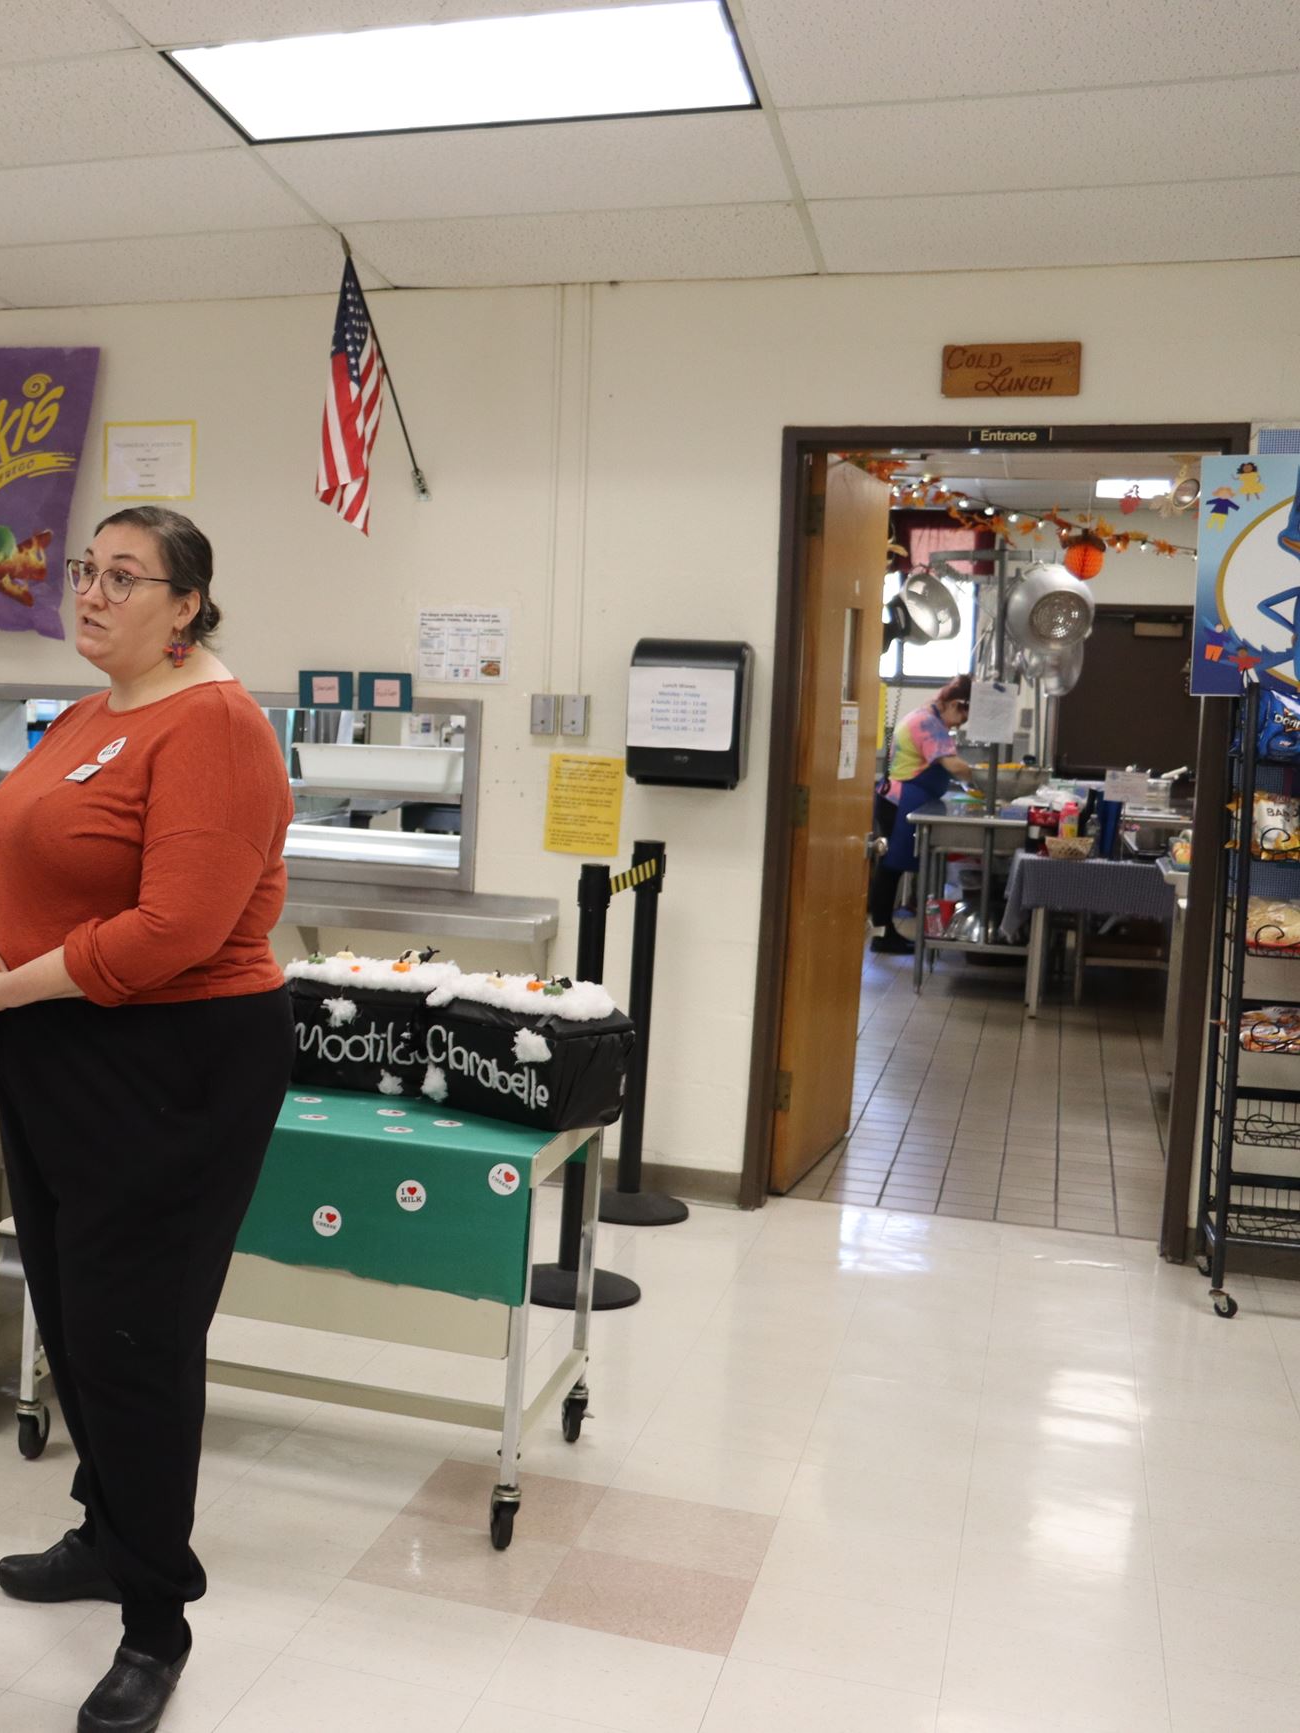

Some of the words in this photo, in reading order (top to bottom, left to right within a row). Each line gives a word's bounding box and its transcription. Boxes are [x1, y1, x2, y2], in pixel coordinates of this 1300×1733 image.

[946, 346, 1003, 370] COLD
[974, 367, 1053, 396] LUNCH
[980, 429, 1038, 441] Entrance
[426, 1024, 550, 1110] Clarabelle
